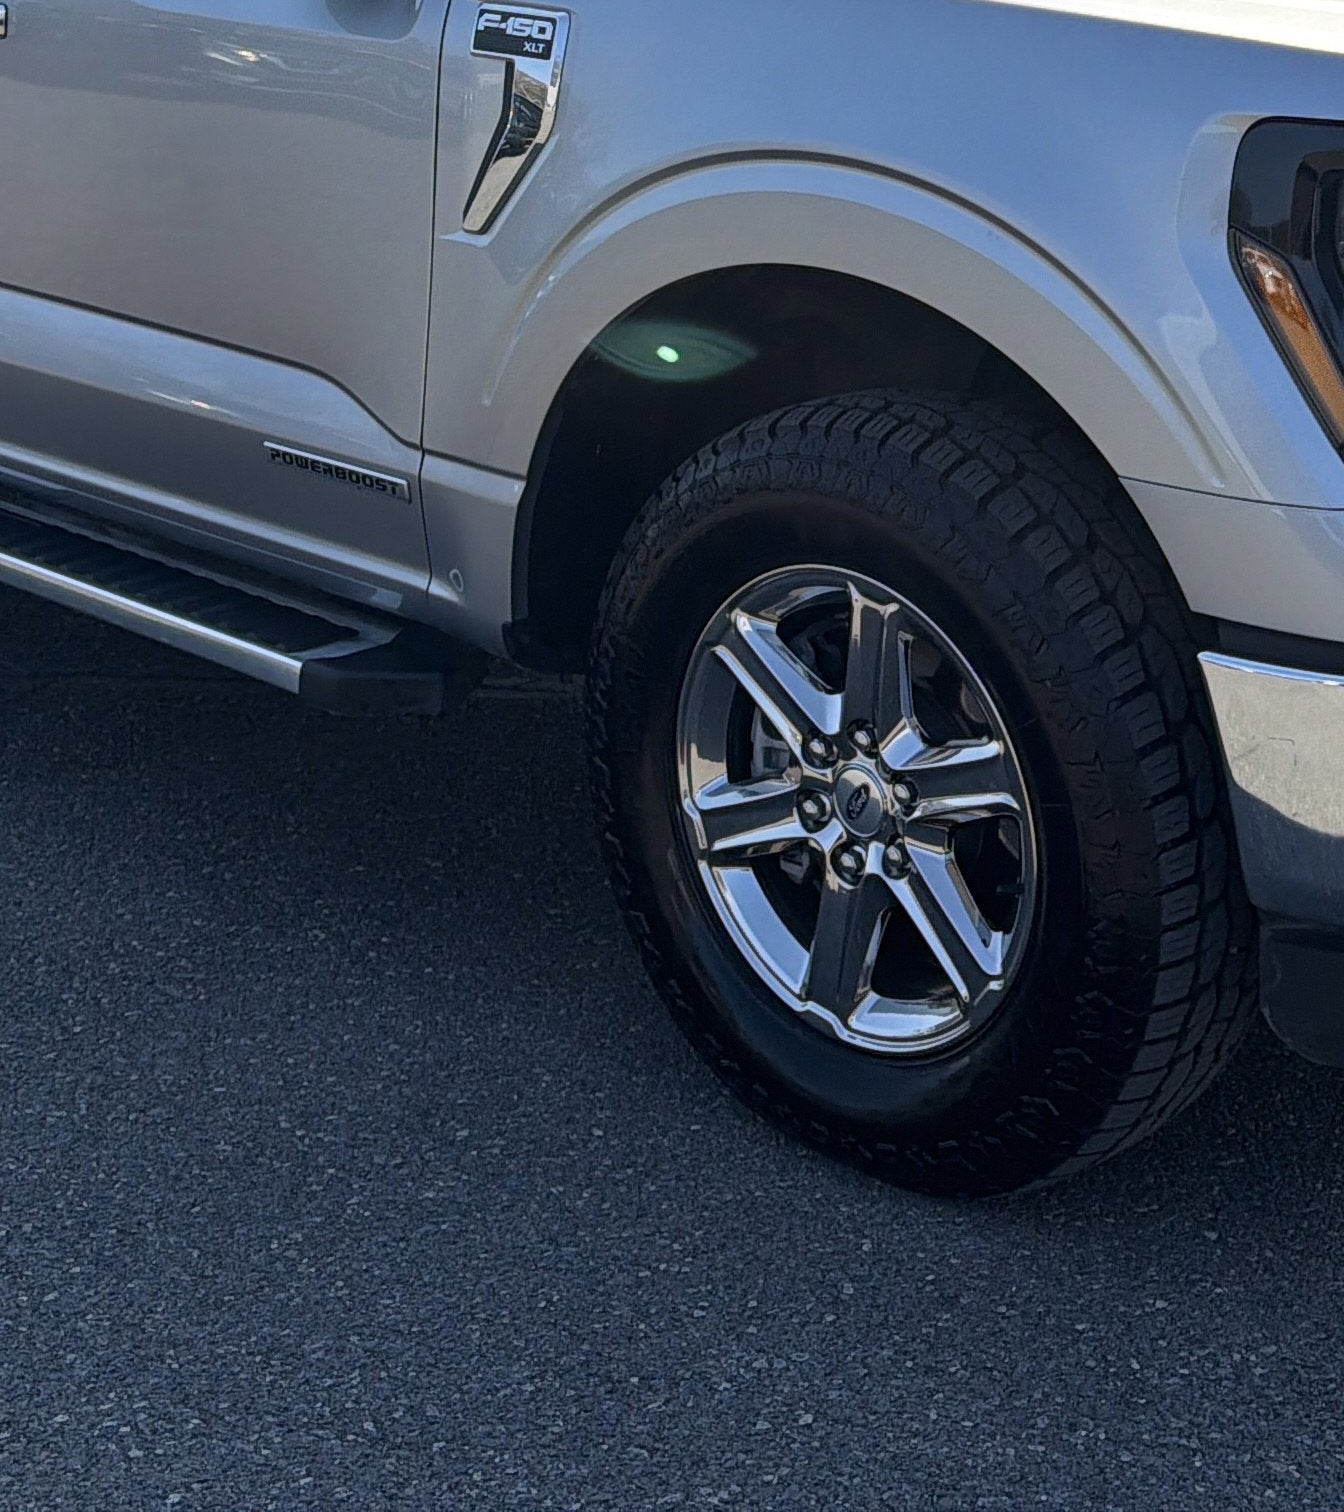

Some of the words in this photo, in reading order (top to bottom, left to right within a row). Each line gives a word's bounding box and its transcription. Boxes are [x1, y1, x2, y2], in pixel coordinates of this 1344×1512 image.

[477, 12, 554, 41] F-150
[522, 40, 546, 54] XLT
[269, 448, 400, 496] POWERBOOST
